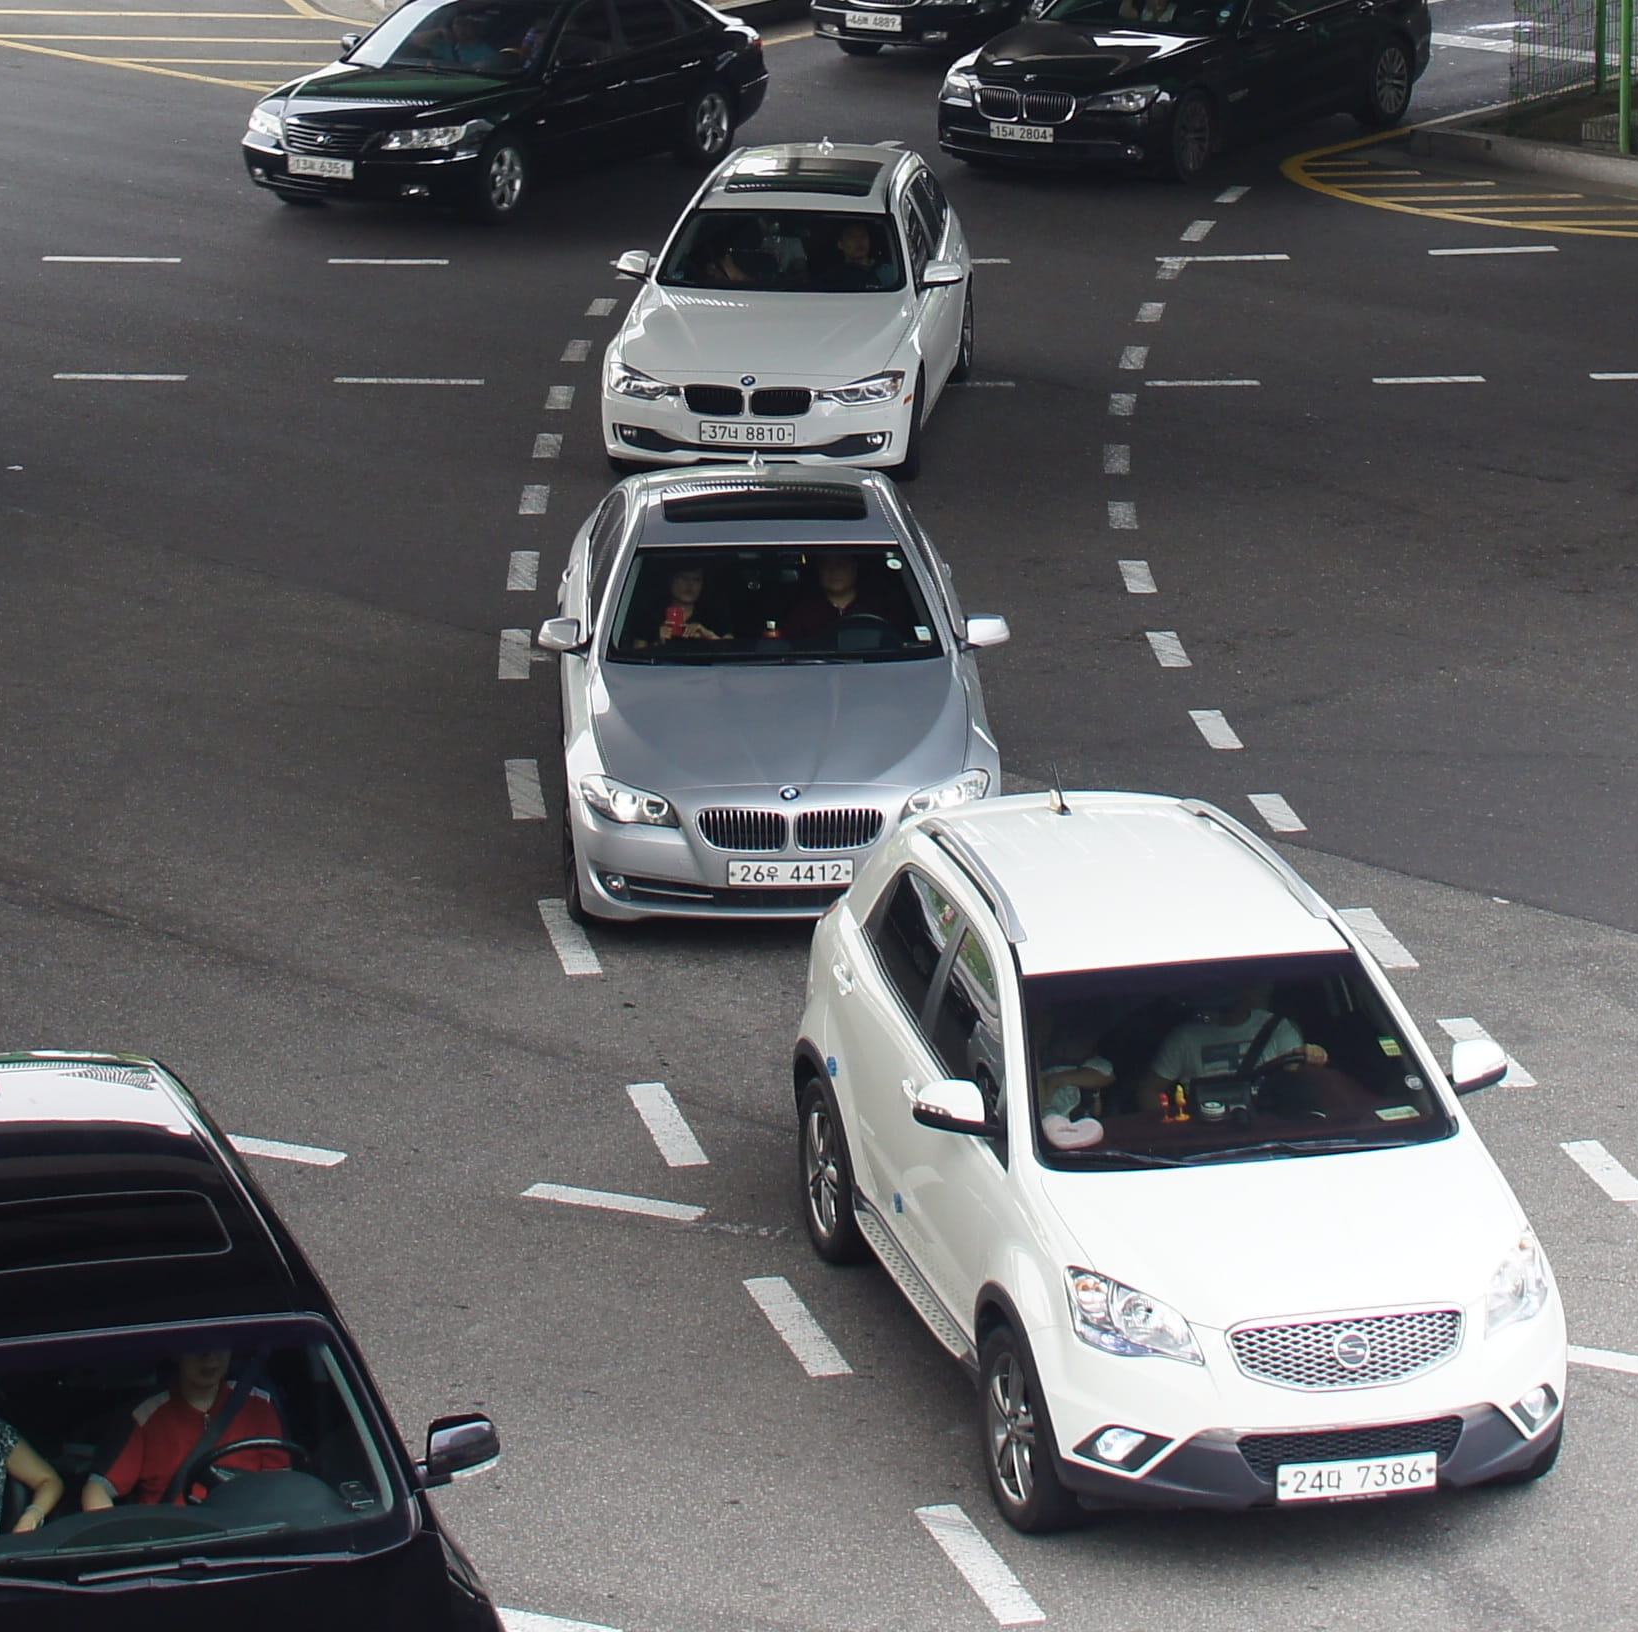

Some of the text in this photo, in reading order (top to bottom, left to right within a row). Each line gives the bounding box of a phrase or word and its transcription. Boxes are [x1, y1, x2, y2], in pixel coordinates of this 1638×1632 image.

[1019, 127, 1047, 140] 2804
[319, 160, 347, 176] 6351
[708, 425, 786, 441] 37너 8810
[739, 863, 843, 883] 26우 4412
[1356, 1460, 1423, 1489] 7386
